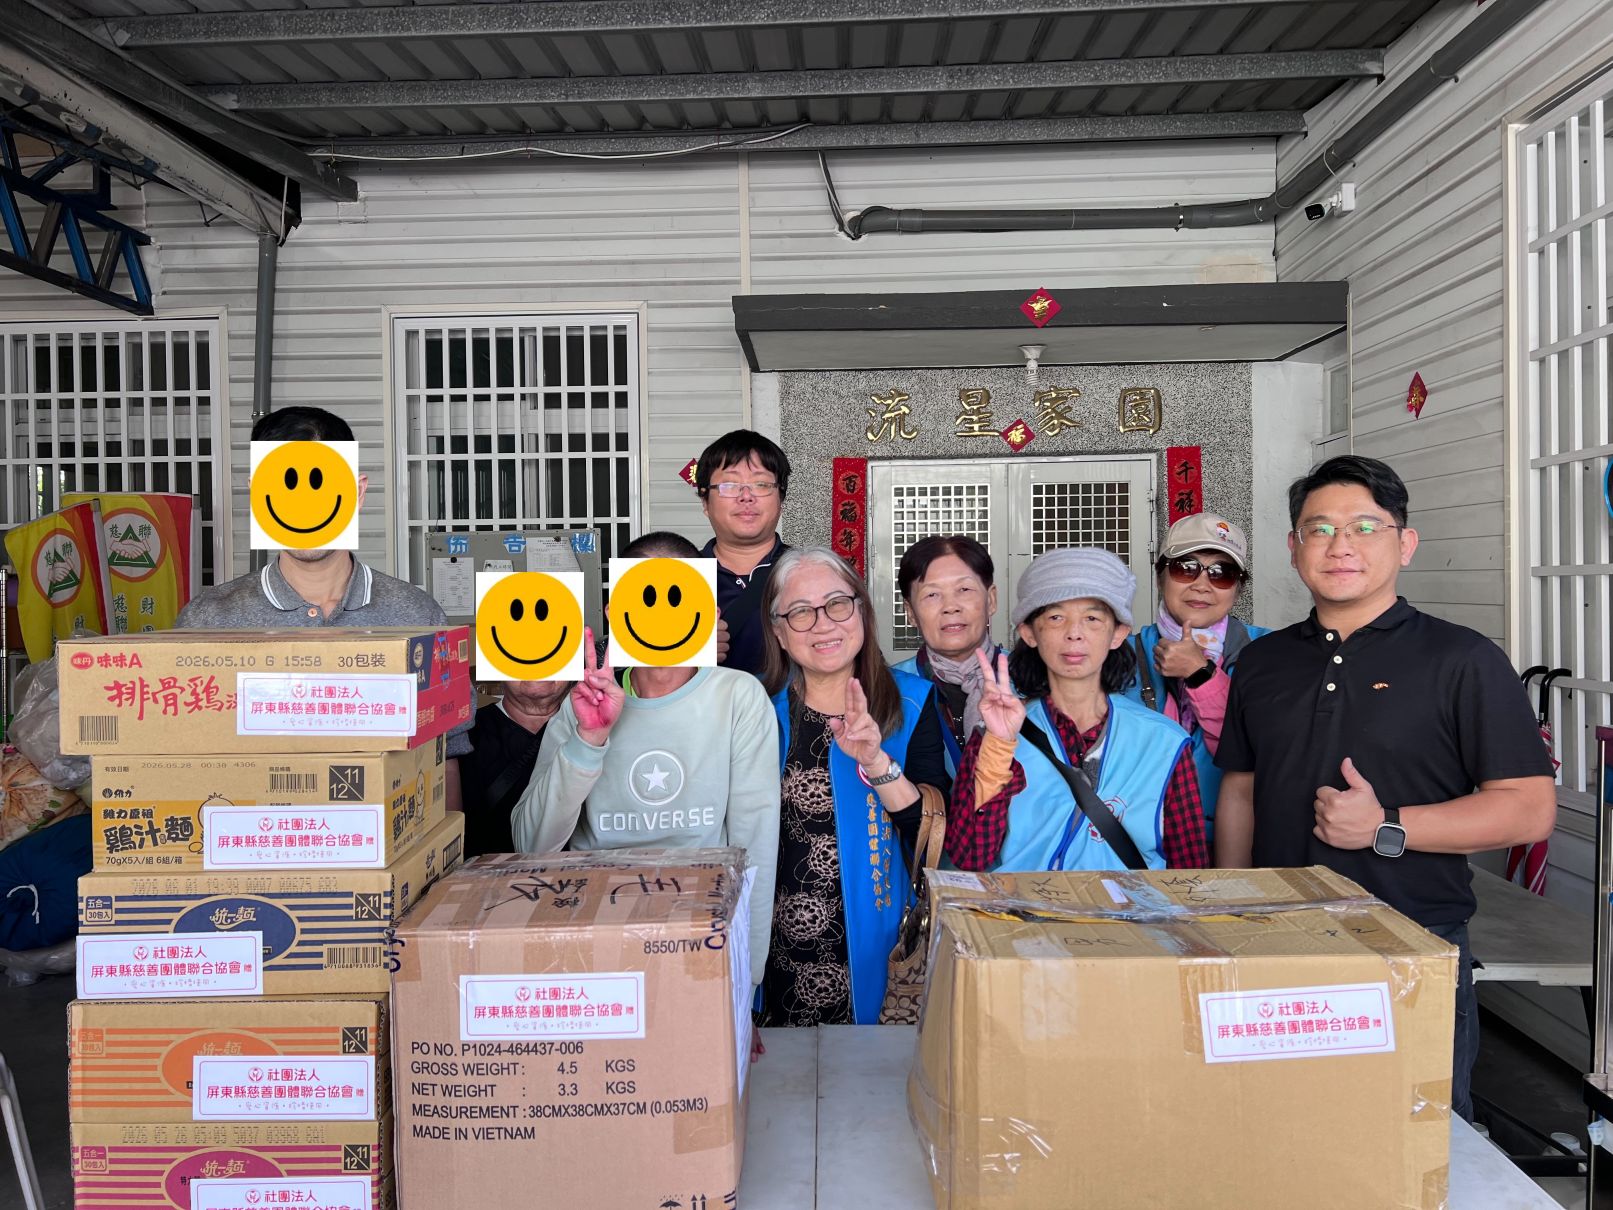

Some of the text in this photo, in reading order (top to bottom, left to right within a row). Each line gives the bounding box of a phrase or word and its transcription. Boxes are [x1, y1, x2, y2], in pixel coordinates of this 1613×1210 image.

[866, 385, 1163, 442] 流星家園
[97, 653, 142, 668] 味味A
[175, 656, 256, 667] 2026.05.10
[284, 656, 322, 667] 15:58
[338, 653, 386, 668] 30包裝
[310, 686, 363, 698] 社團法人
[251, 702, 396, 715] 屏東縣慈善團體聯合協會
[344, 769, 359, 784] 11
[330, 784, 348, 798] 12
[277, 818, 330, 831] 社團法人
[217, 834, 363, 848] 屏東縣慈善團體聯合協會
[87, 899, 110, 908] 五合一
[368, 896, 379, 908] 11
[356, 907, 369, 918] 12
[152, 946, 207, 959] 社團法人
[643, 939, 702, 954] 8550/TW
[91, 961, 241, 978] 屏東縣慈善團體聯合協會
[535, 986, 589, 1000] 社團法人
[474, 1003, 623, 1019] 屏東縣慈善團體聯合協會
[1278, 1000, 1333, 1016] 社團法人
[355, 1029, 366, 1040] 11
[1217, 1016, 1370, 1039] 屏東縣慈善團體聯合協會
[343, 1041, 356, 1053] 12
[411, 1041, 584, 1057] PO NO. P1024-464437-006
[411, 1061, 458, 1076] GROSS
[557, 1061, 578, 1075] 4.5
[605, 1059, 636, 1073] KGS
[267, 1068, 320, 1082] 社團法人
[207, 1085, 353, 1099] 屏東縣慈善團體聯合協會
[411, 1082, 438, 1096] NET
[441, 1084, 497, 1098] WEIGHT
[557, 1083, 578, 1097] 3.3
[605, 1081, 636, 1095] KGS
[412, 1103, 519, 1119] MEASUREMENT
[650, 1097, 708, 1118] (0.053M3)
[412, 1125, 536, 1140] MADE IN VIETNAM
[356, 1147, 368, 1158] 11
[345, 1158, 357, 1169] 12
[264, 1190, 317, 1203] 社團法人
